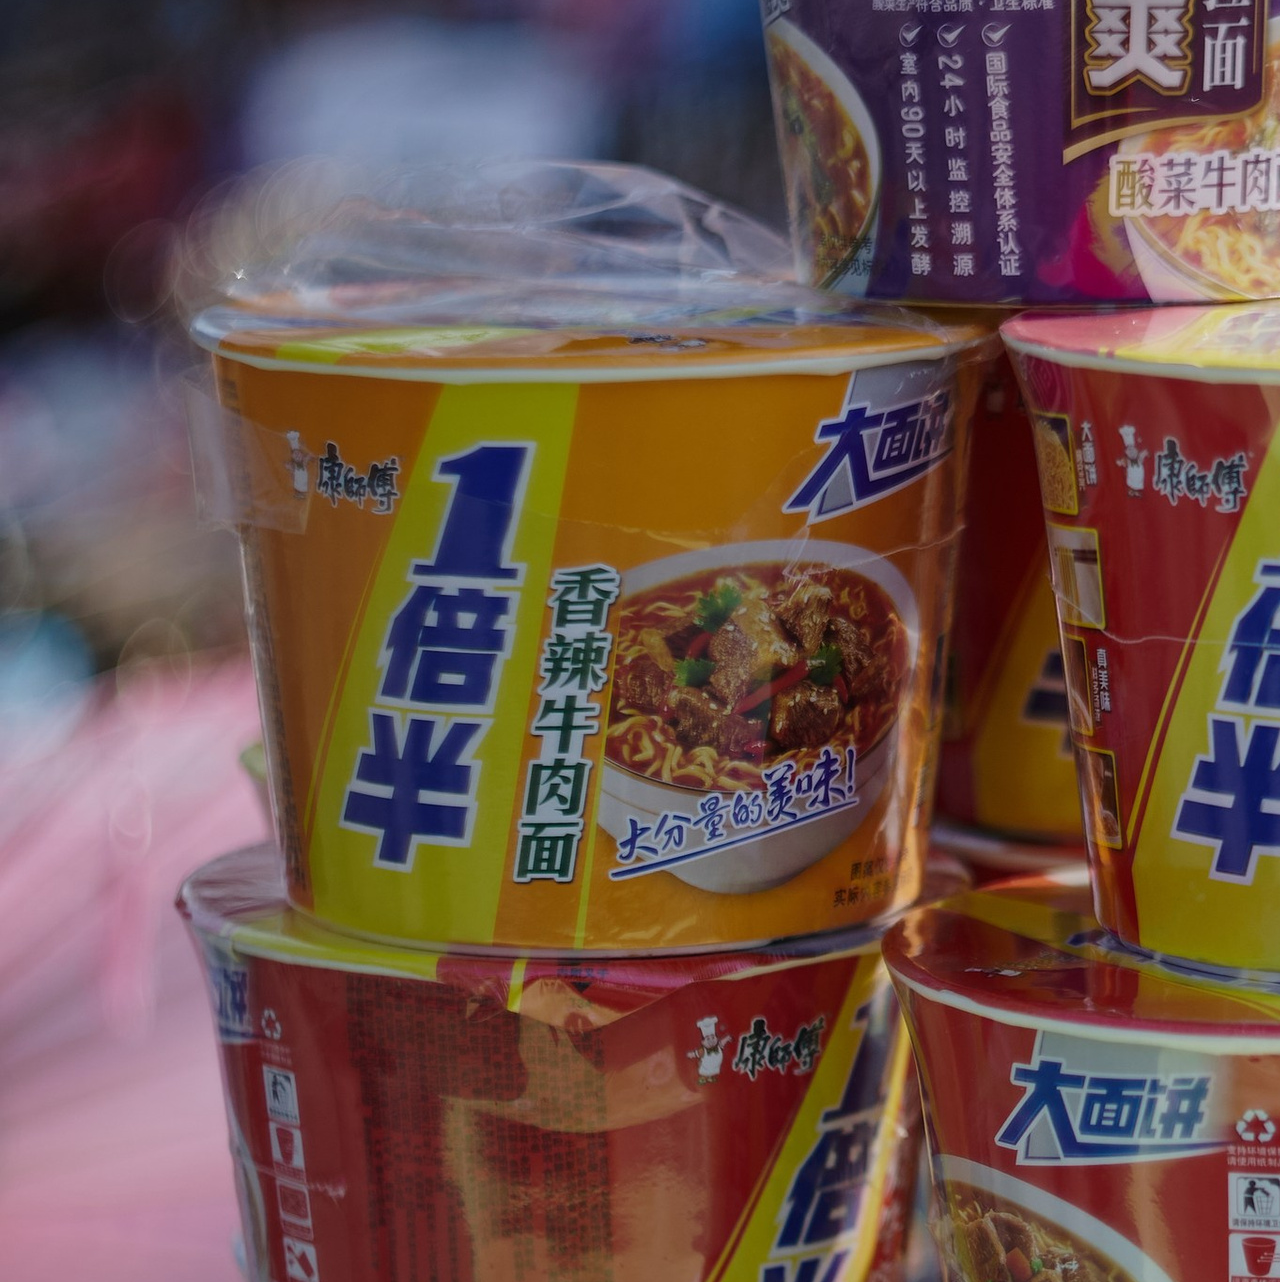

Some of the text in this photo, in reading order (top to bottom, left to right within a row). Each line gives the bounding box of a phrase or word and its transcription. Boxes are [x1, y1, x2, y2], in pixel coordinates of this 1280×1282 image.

[899, 53, 932, 277] 室内90天以上发酵
[938, 54, 975, 277] 24小时监控溯源
[985, 52, 1021, 277] 国际食品安全体系认证
[317, 441, 399, 514] 康師傅
[1154, 439, 1249, 512] 康師傅
[343, 446, 530, 865] 1倍半
[514, 567, 619, 880] 香辣牛肉面
[619, 749, 857, 861] 大分量的美味!
[732, 1017, 824, 1080] 康師傅
[997, 1060, 1211, 1157] 大面饼
